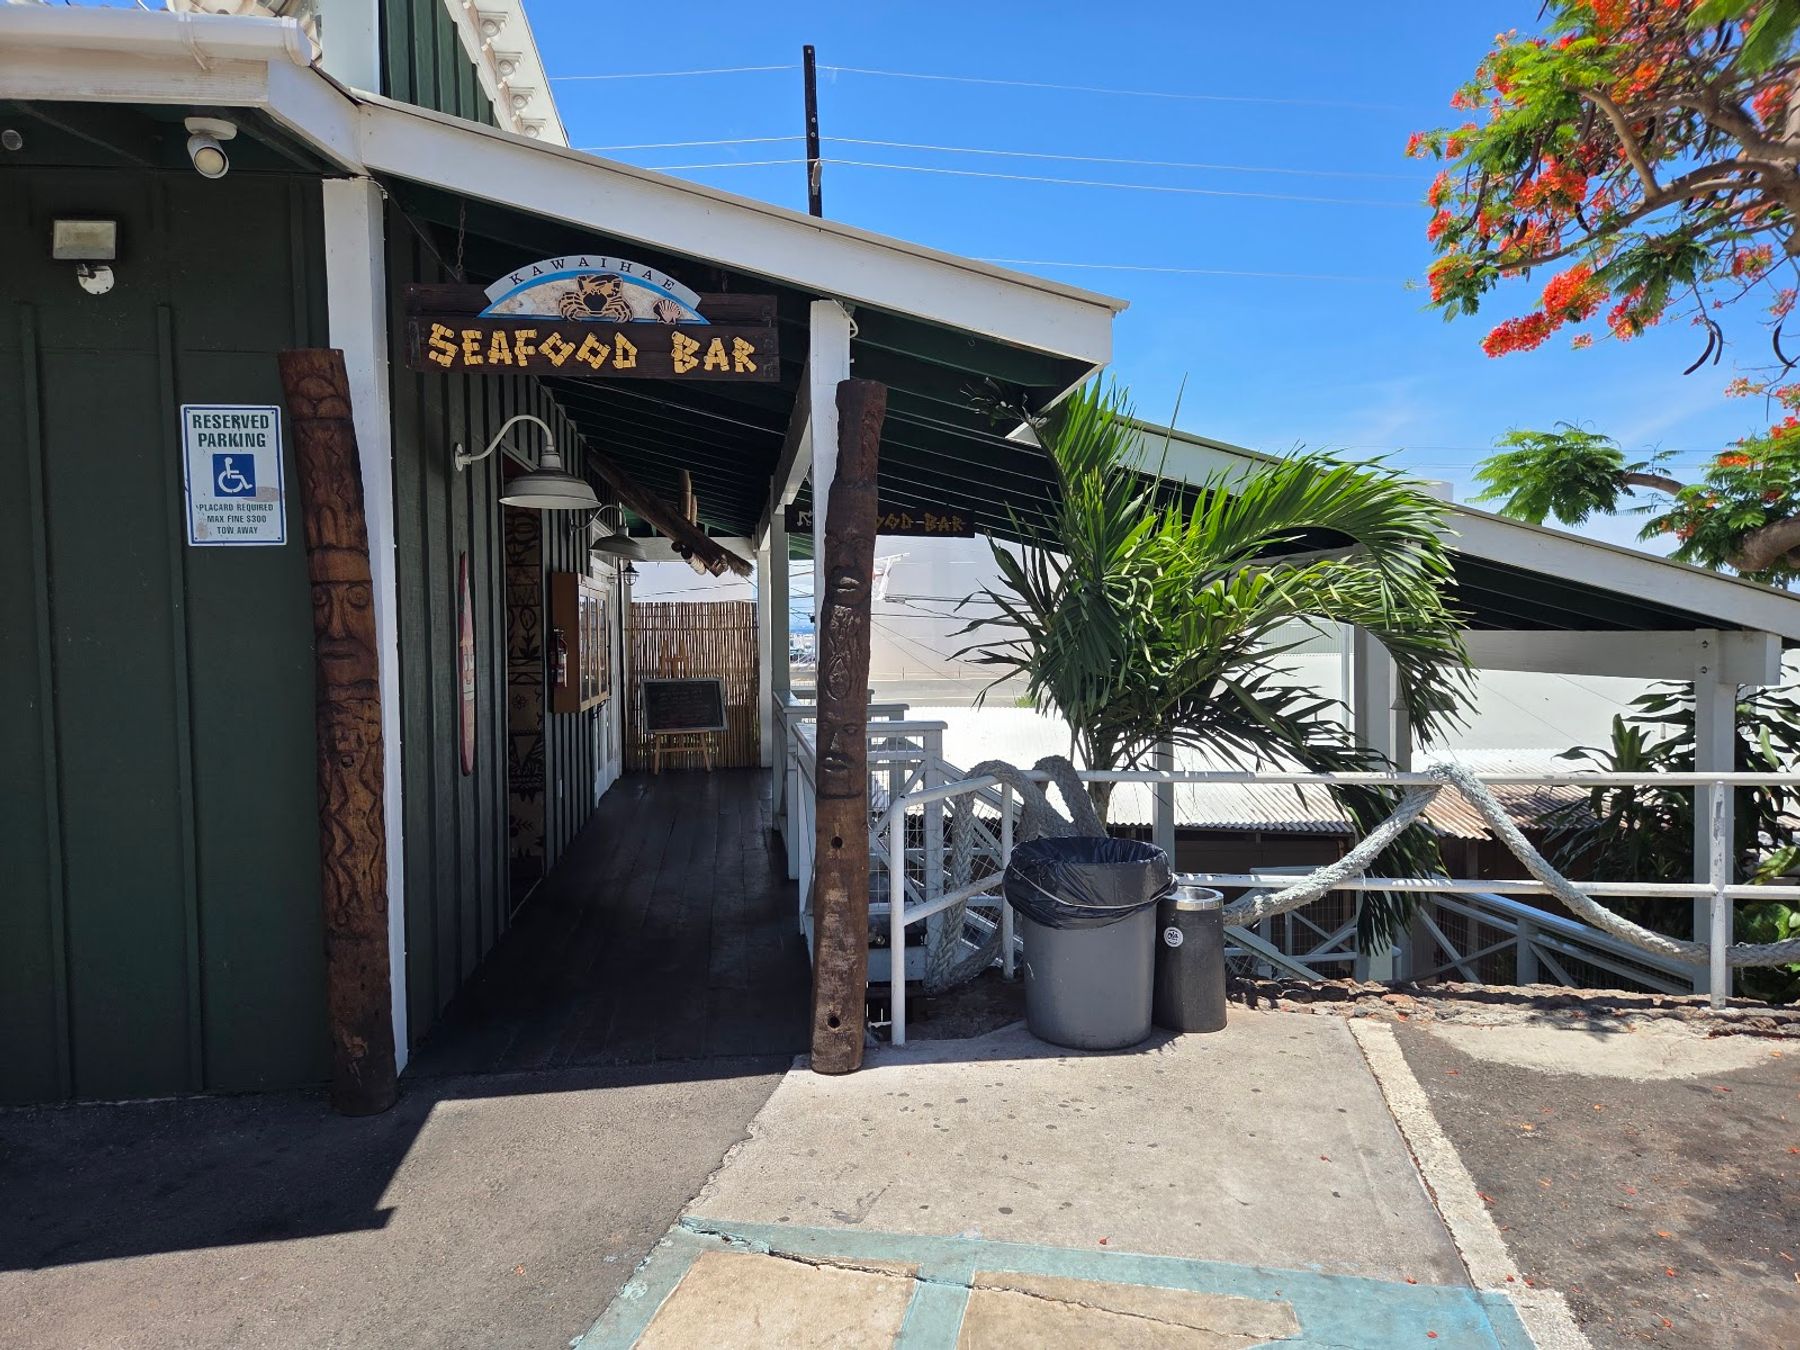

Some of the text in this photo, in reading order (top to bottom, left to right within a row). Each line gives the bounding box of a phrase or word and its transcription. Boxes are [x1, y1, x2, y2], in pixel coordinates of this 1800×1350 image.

[509, 257, 675, 292] KAWAIHAE
[429, 323, 758, 375] SEAFOOD BAR
[192, 414, 269, 430] RESERVED
[198, 432, 267, 448] PARKING
[199, 503, 274, 512] PLACARD REQUIRED
[207, 515, 267, 523] MAX FINE $300
[924, 512, 964, 532] BAR
[217, 526, 259, 535] TOW AWAY
